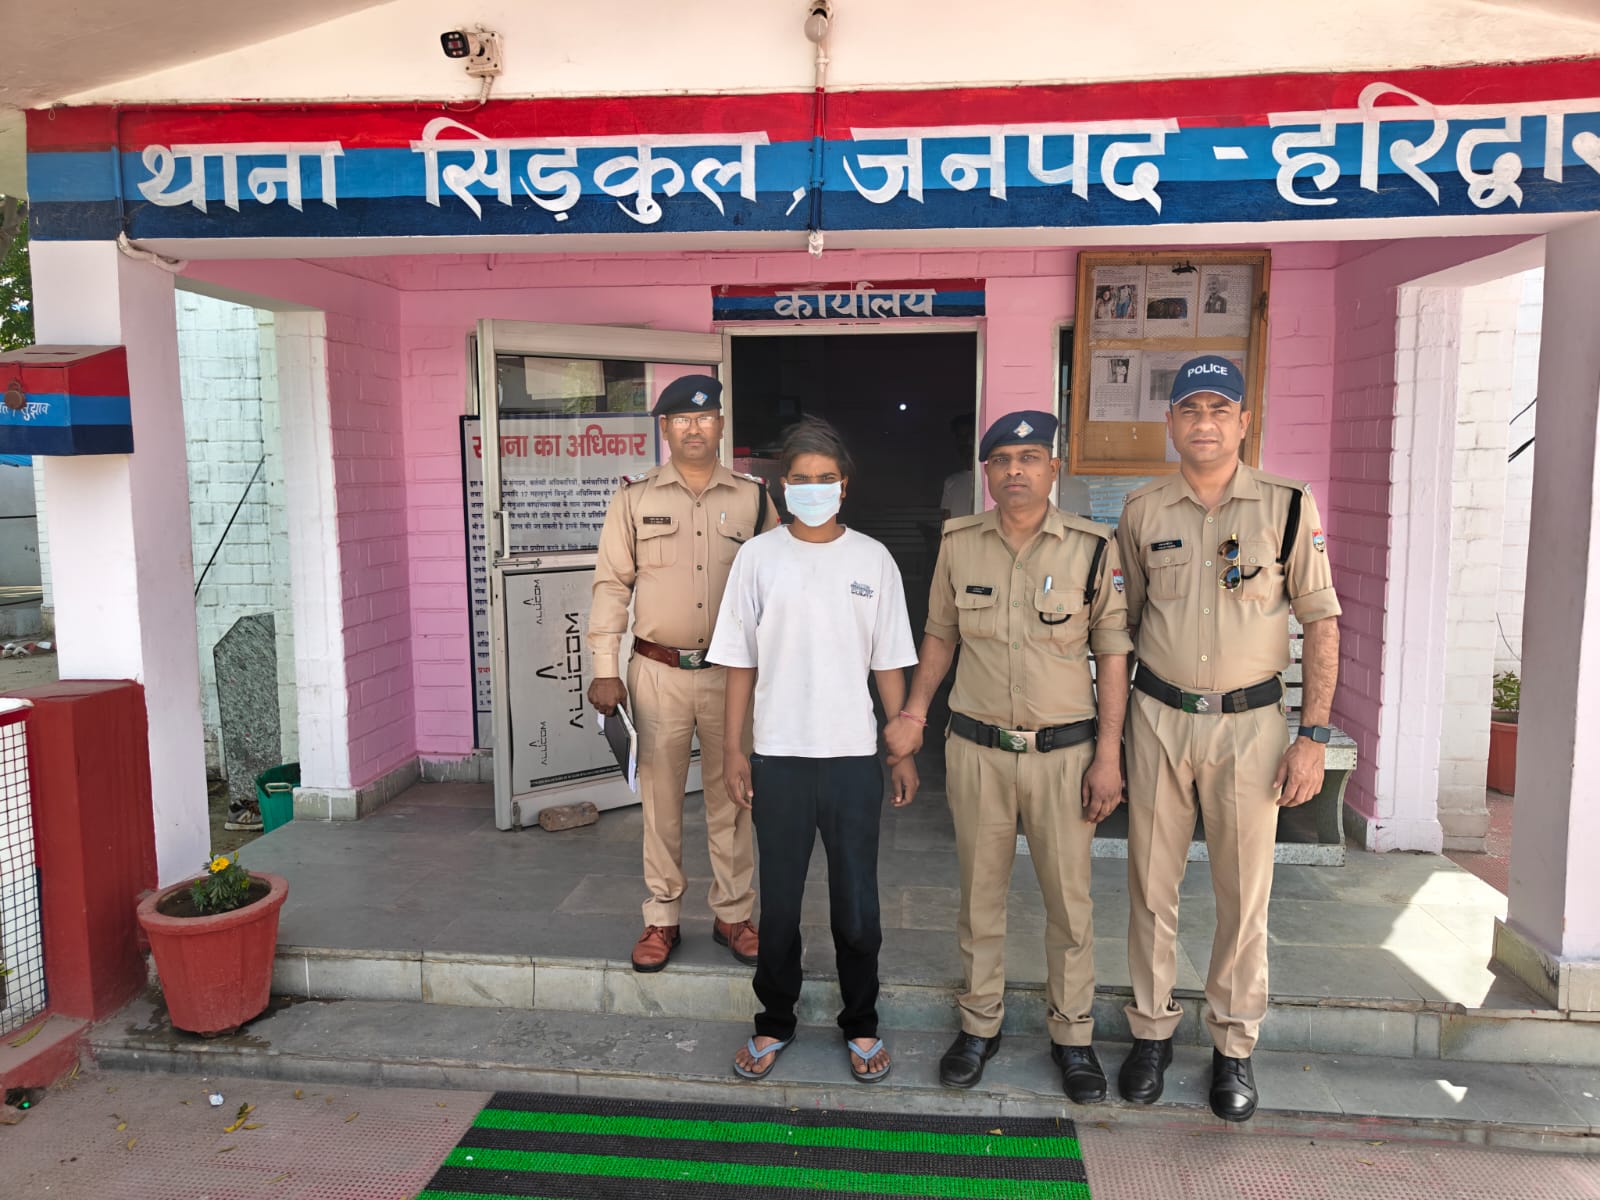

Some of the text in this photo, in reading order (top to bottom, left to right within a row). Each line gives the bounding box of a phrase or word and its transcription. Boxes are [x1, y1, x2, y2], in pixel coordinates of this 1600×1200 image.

[137, 141, 344, 213] थाना
[410, 117, 769, 224] सिड़कुल
[843, 117, 1180, 216] जनपद
[774, 281, 937, 319] कार्यालय
[1187, 363, 1229, 378] POLICE
[472, 424, 647, 458] सना का अधिकार
[564, 612, 584, 729] ALUCOM
